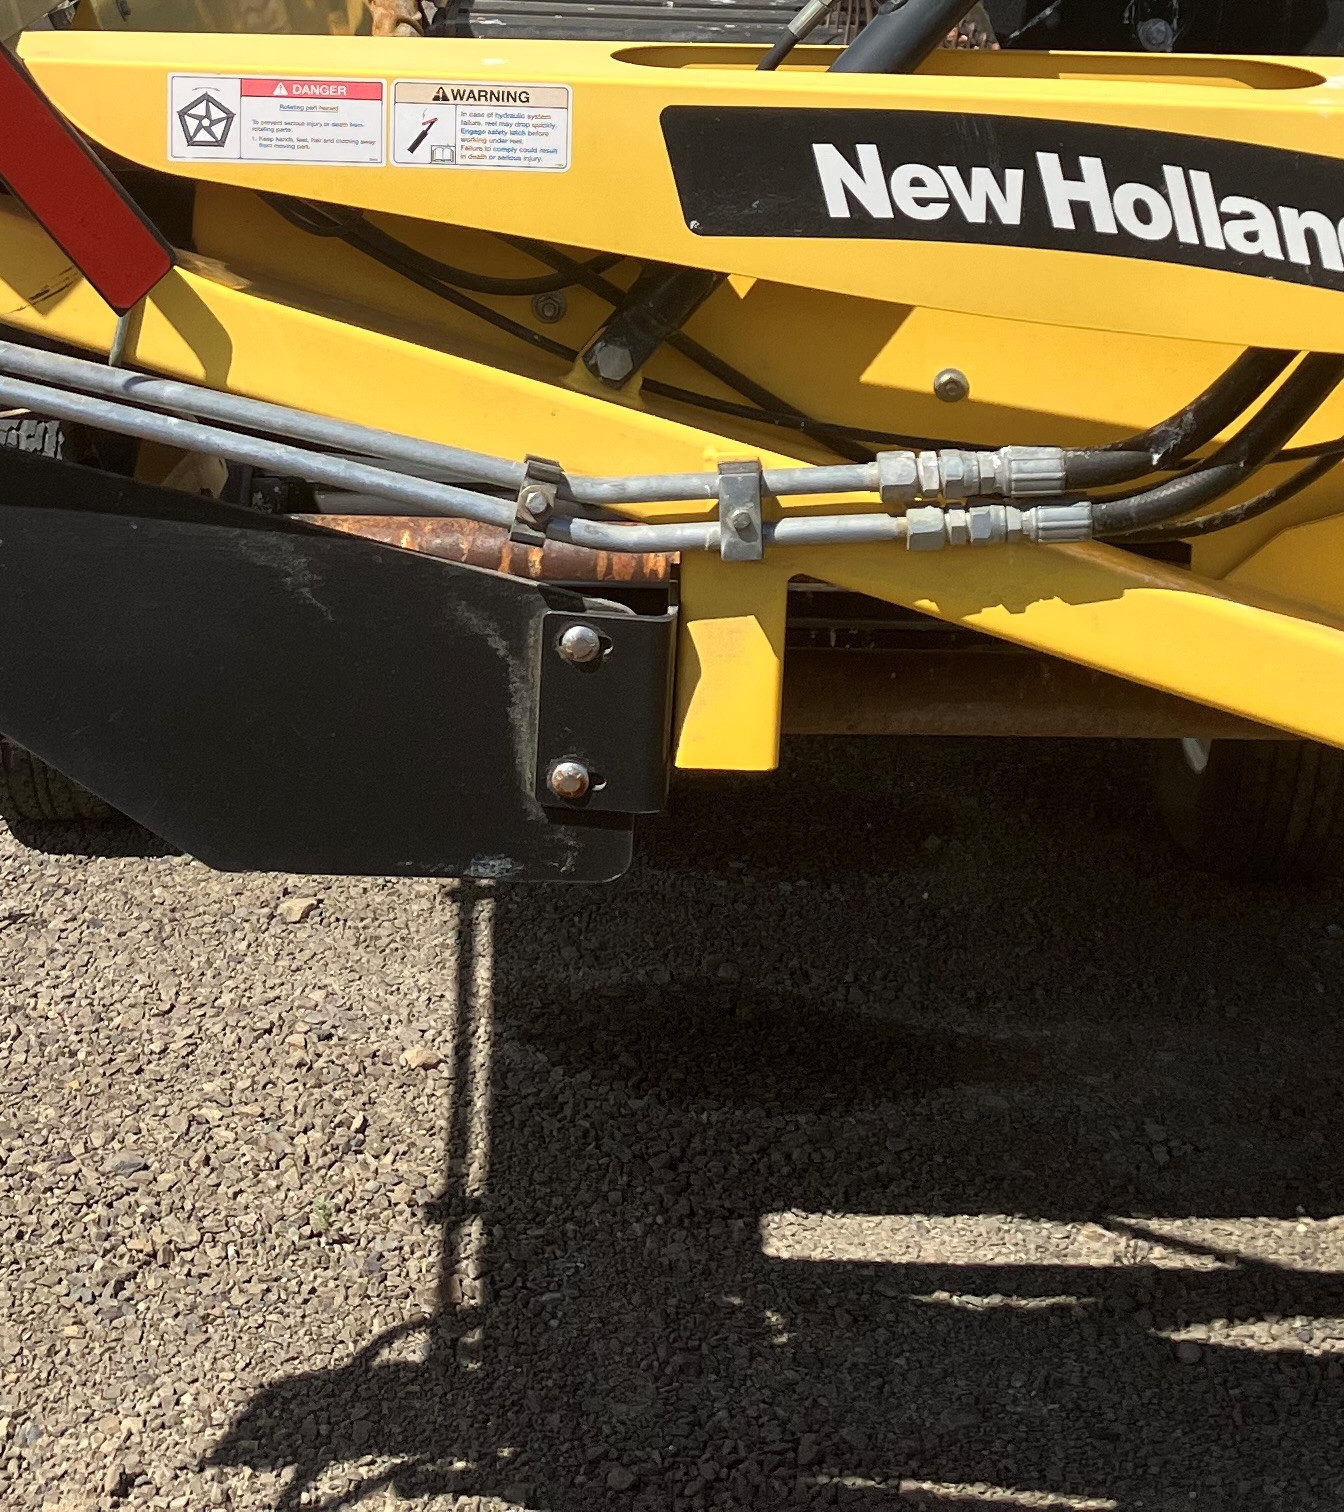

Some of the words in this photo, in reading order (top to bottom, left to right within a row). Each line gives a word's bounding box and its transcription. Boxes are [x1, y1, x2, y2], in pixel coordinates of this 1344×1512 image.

[292, 84, 347, 96] DANGER
[451, 88, 530, 104] WARNING
[514, 121, 531, 129] drop
[460, 128, 487, 136] Engage
[487, 129, 508, 137] safety
[492, 146, 518, 154] comply
[812, 143, 1025, 225] New
